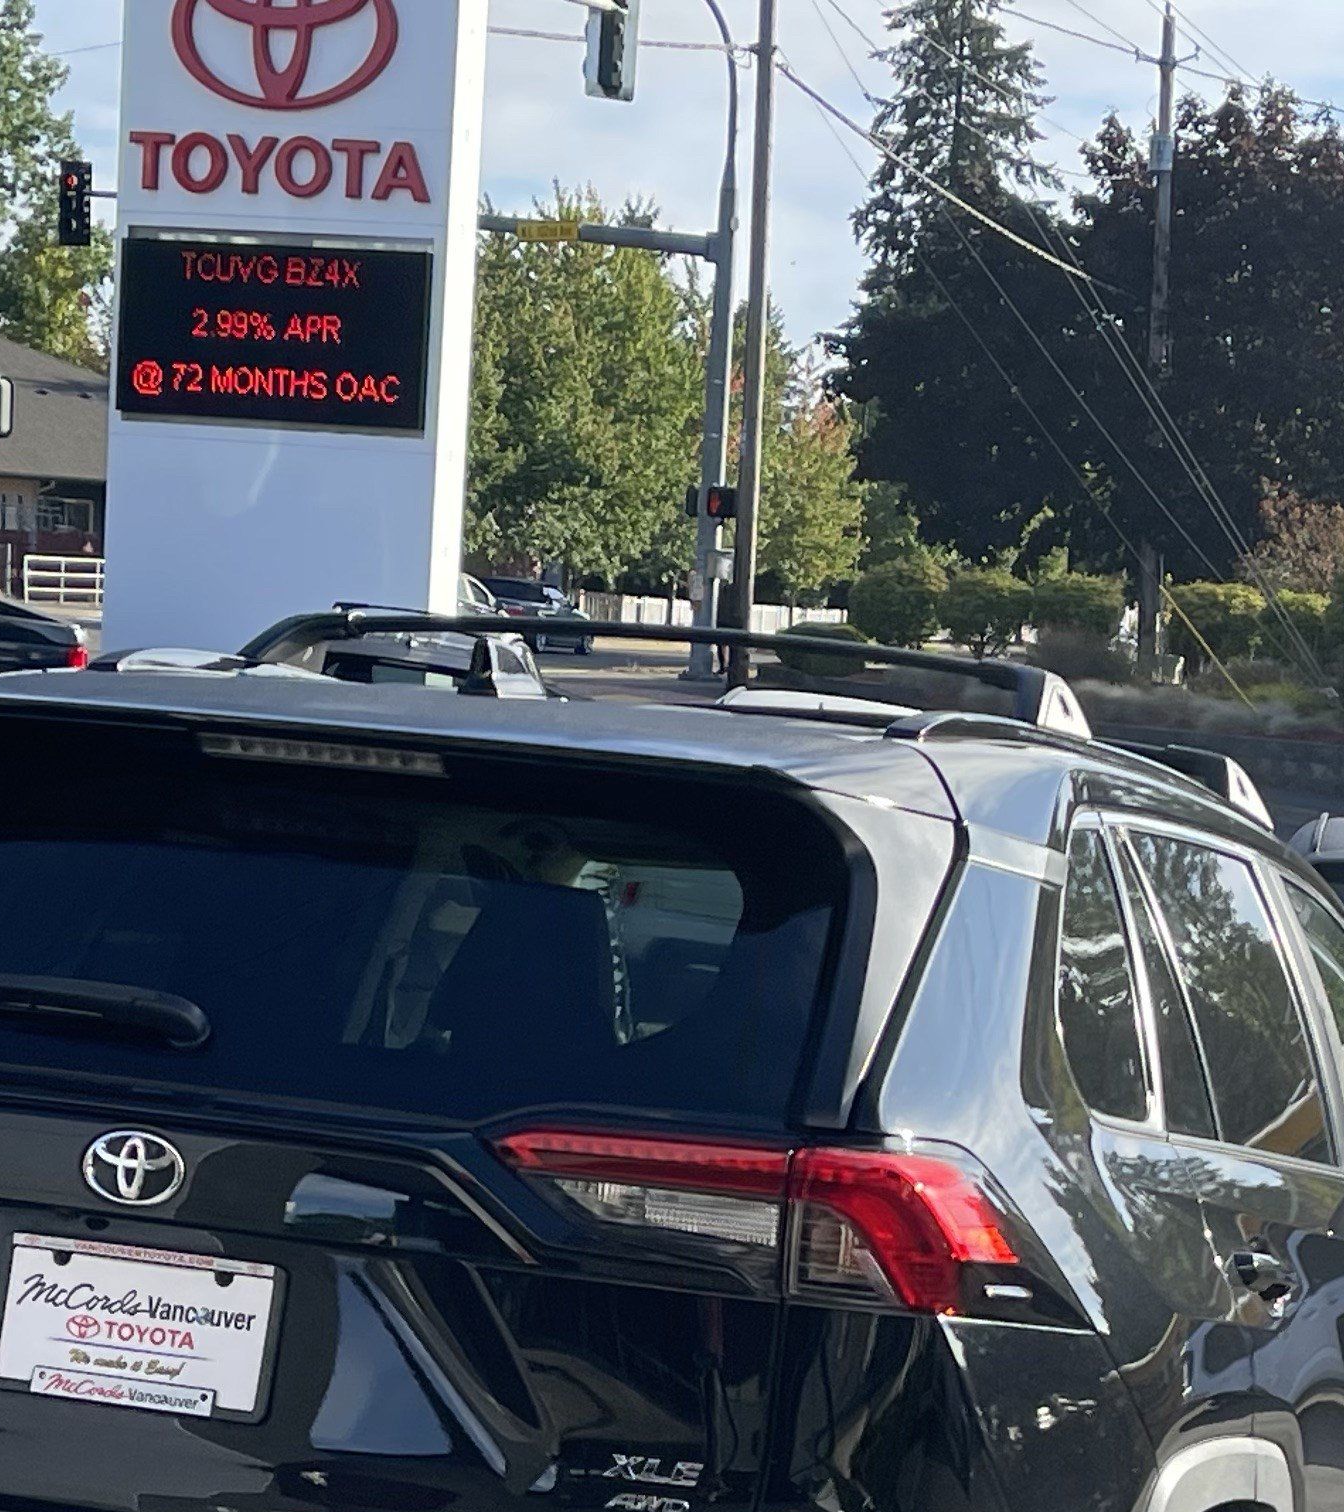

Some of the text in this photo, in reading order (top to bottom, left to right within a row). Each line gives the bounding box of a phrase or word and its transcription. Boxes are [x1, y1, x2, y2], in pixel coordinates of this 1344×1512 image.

[129, 131, 431, 203] TOYOTA
[284, 256, 361, 288] BZ4X
[191, 307, 343, 345] 2.99% APR
[131, 360, 401, 404] @ 72 MONTHS OAC
[104, 1320, 196, 1350] TOYOTA
[602, 1453, 705, 1488] XLE
